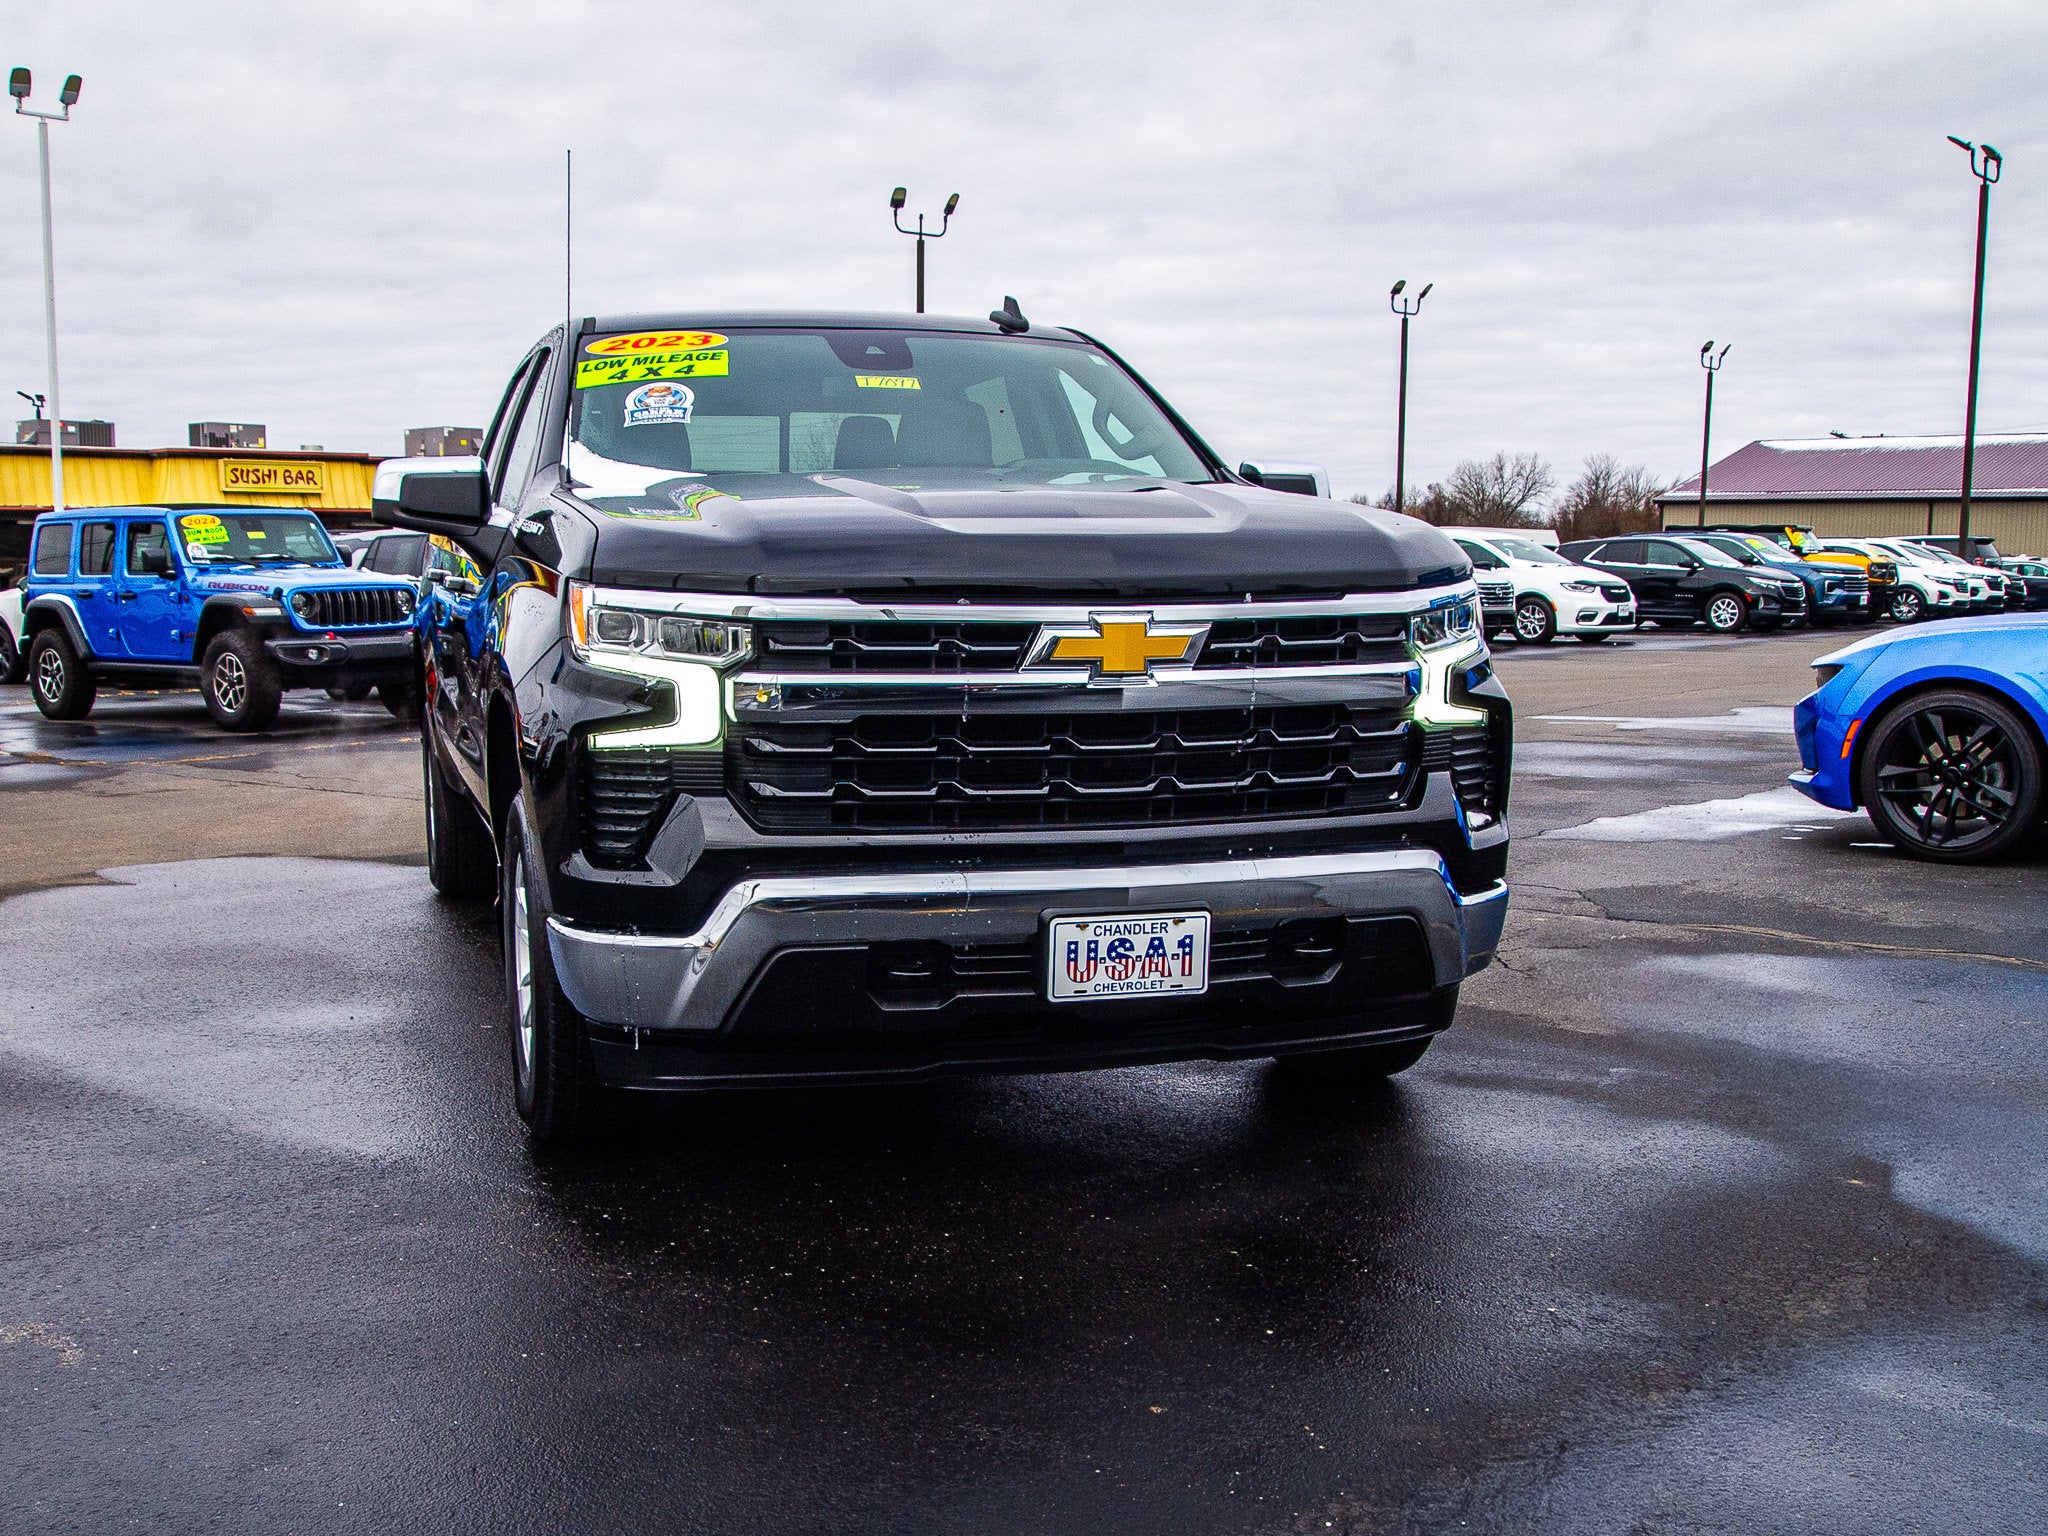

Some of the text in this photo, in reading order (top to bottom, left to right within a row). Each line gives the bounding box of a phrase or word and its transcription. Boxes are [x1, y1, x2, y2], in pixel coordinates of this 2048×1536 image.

[602, 335, 713, 352] 2023
[582, 352, 724, 373] LOW MILEAGE
[608, 364, 695, 381] 4 X 4
[229, 467, 318, 485] SUSHI BAR
[187, 517, 216, 526] 2024
[208, 581, 270, 592] RUBICON
[1093, 922, 1169, 937] CHANDLER
[1093, 980, 1165, 993] CHEVROLET
